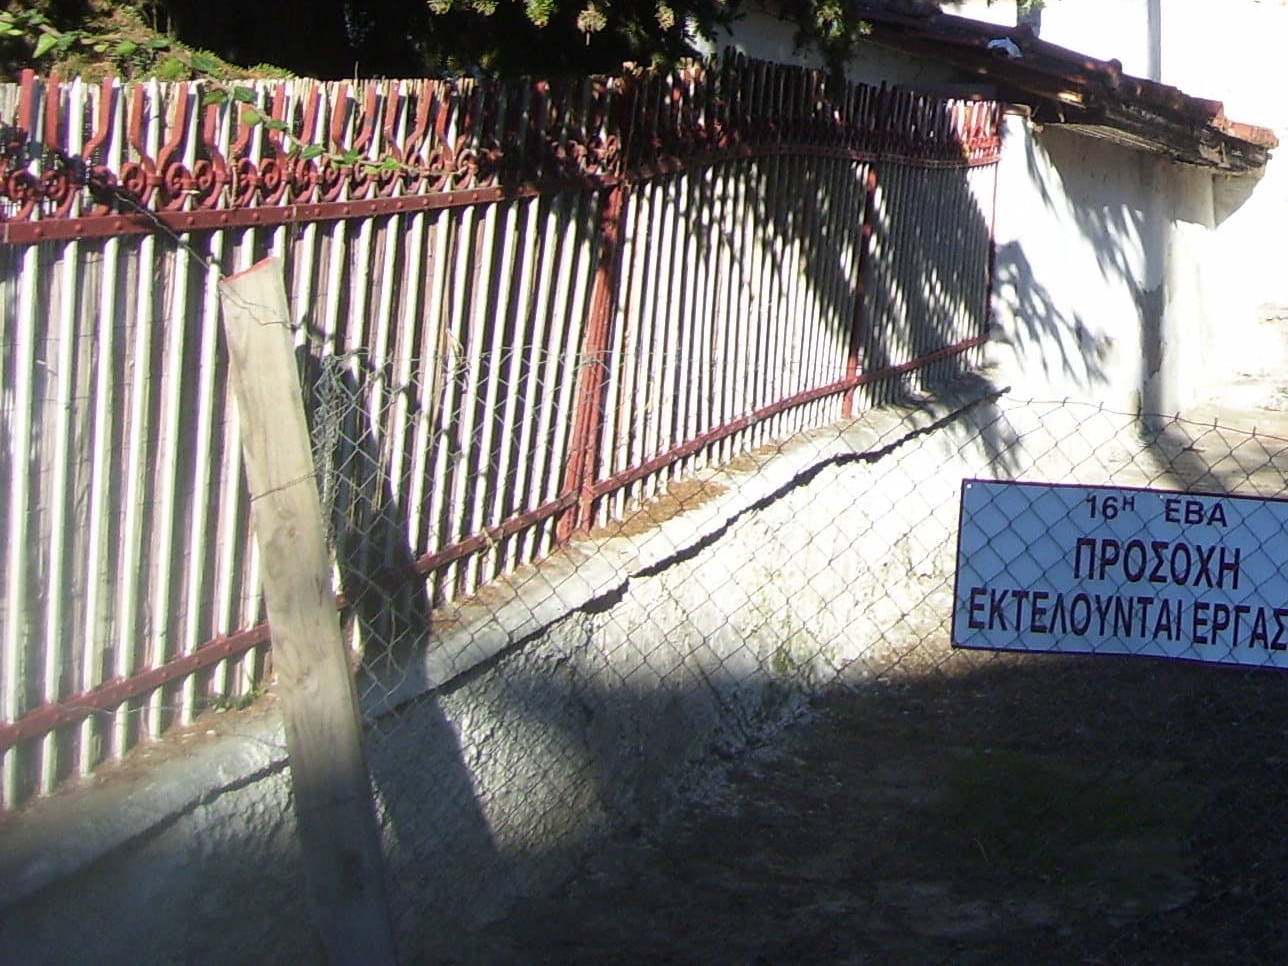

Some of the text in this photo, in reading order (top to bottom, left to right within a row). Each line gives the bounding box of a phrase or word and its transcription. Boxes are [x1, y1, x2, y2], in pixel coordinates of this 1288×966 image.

[1165, 499, 1228, 527] ΕΒΑ
[1074, 538, 1240, 590] ΠΡΟΣΟΧΗ
[968, 587, 1182, 641] ΕΚΤΕΛΟΥΝΤΑΙ
